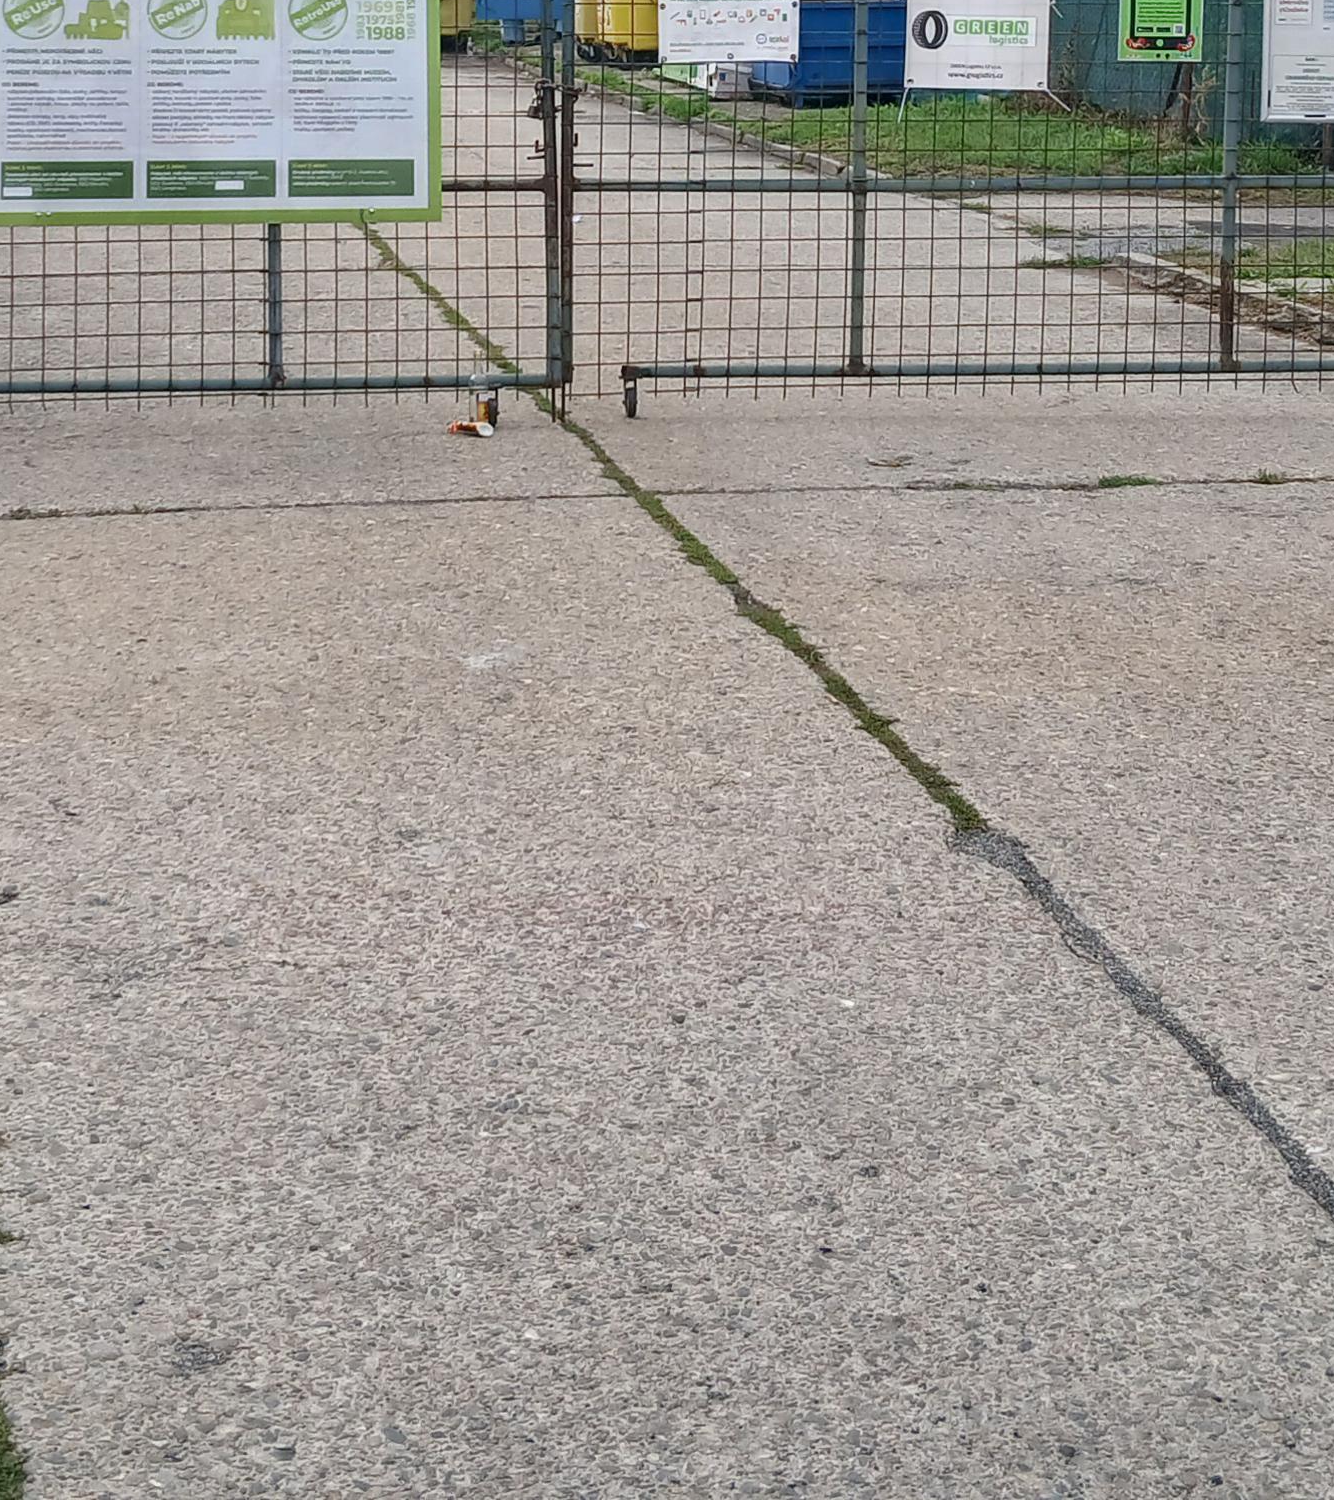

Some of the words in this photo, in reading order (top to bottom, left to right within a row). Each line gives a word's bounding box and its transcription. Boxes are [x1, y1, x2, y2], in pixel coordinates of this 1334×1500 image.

[355, 0, 393, 13] 1969
[365, 26, 405, 41] 1988
[955, 20, 1028, 35] GREEN
[989, 35, 1028, 46] logistics
